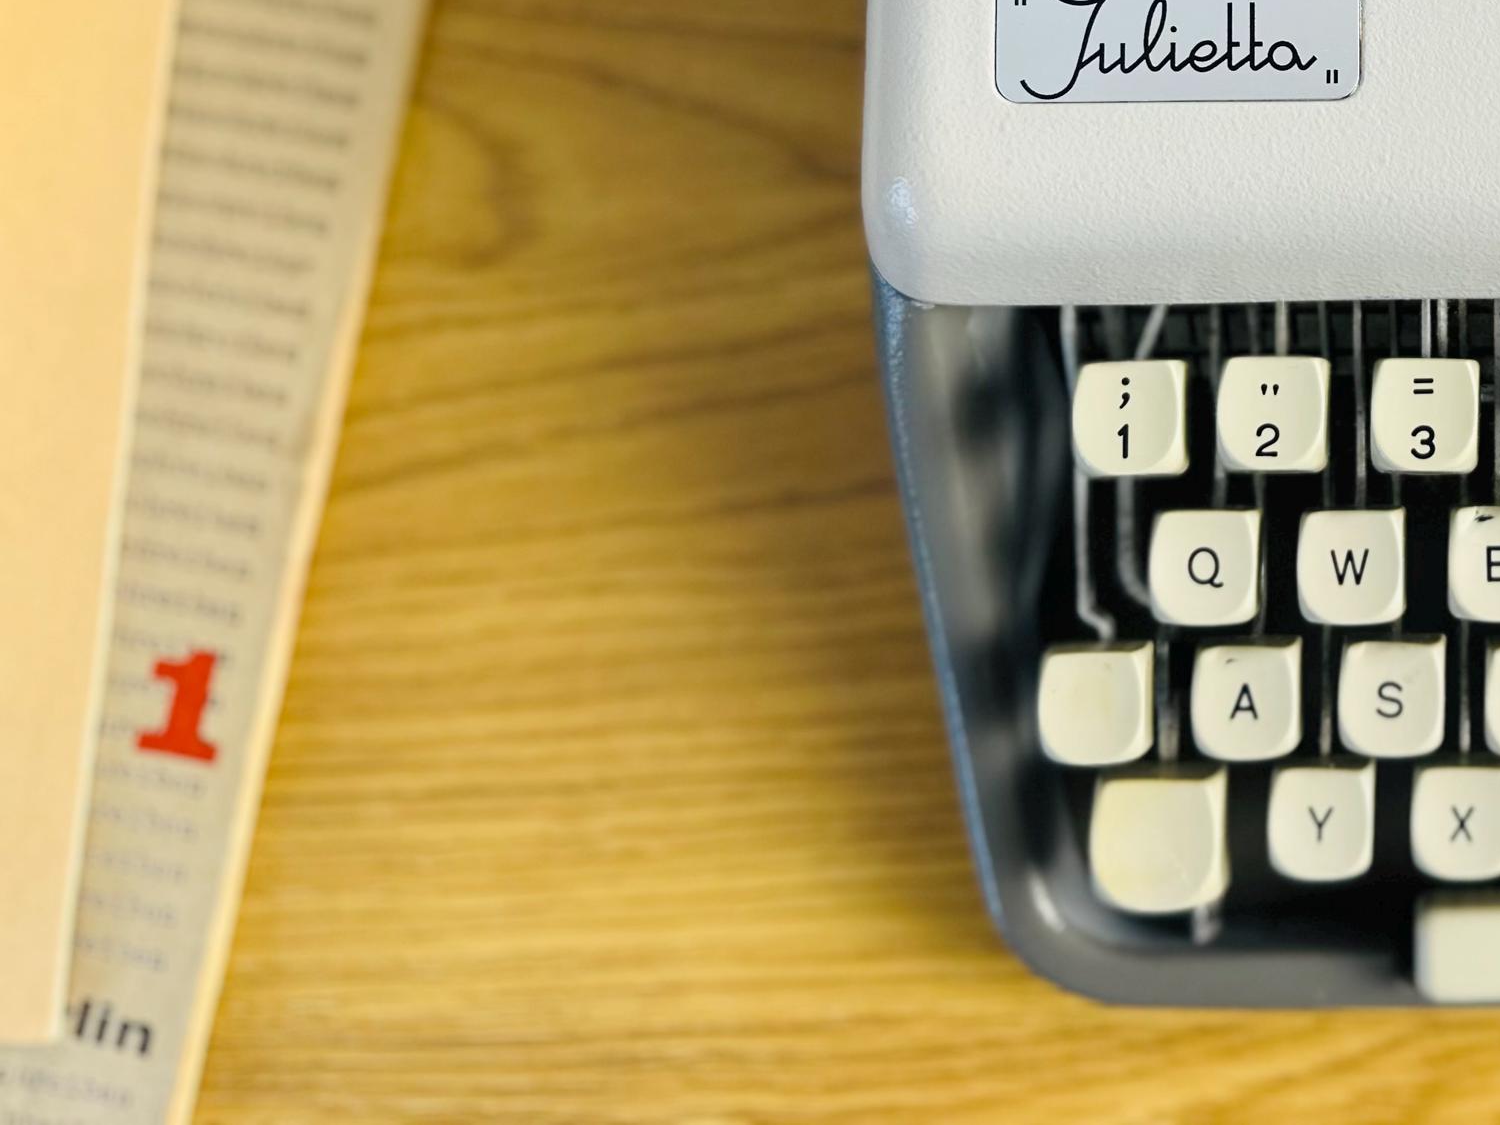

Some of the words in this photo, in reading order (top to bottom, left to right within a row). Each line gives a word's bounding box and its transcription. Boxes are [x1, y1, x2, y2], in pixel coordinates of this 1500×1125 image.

[1119, 377, 1131, 410] ;
[1412, 377, 1435, 395] =
[1117, 423, 1129, 460] 1
[1255, 422, 1280, 458] 2
[1410, 424, 1436, 460] 3
[1187, 546, 1224, 589] Q
[1330, 548, 1370, 586] W
[136, 650, 218, 764] 1
[1230, 683, 1258, 720] A
[1376, 680, 1404, 719] S
[1308, 807, 1333, 841] Y
[1450, 806, 1475, 842] X
[66, 997, 154, 1056] lin
